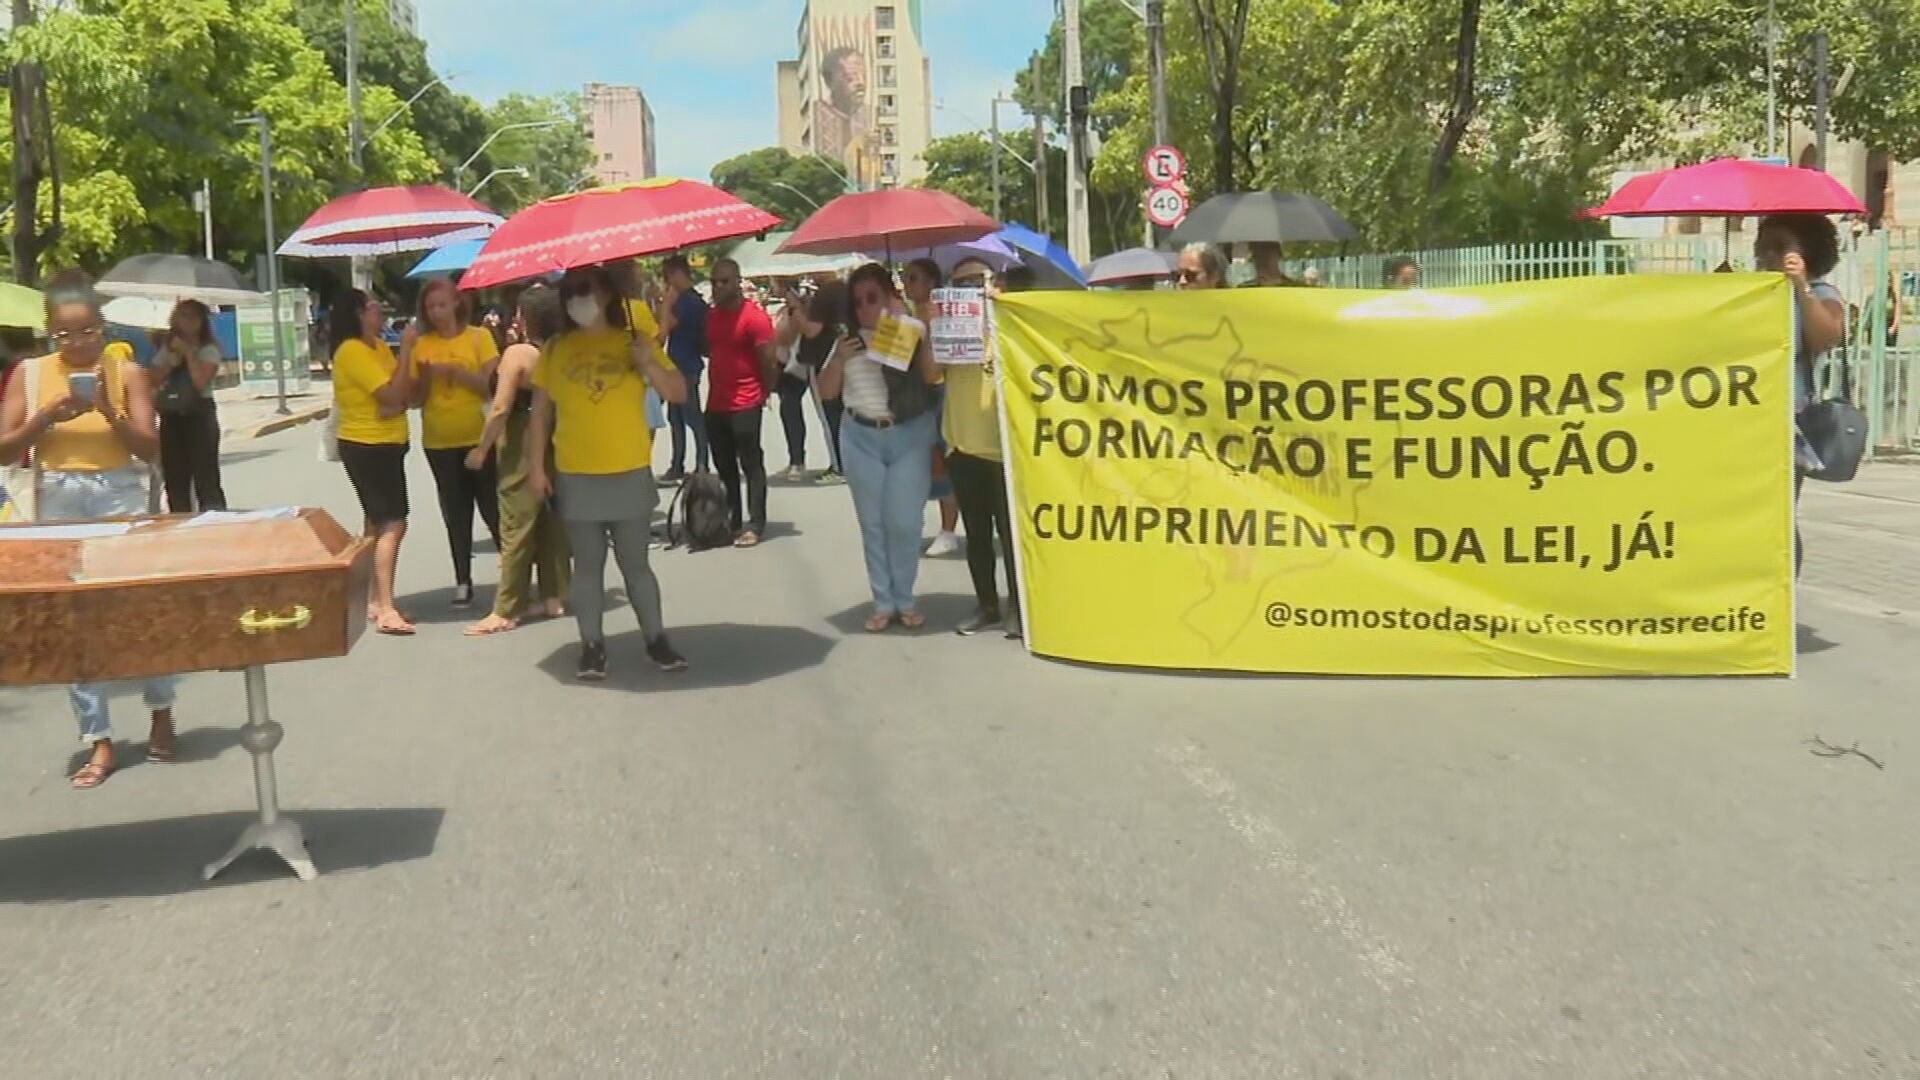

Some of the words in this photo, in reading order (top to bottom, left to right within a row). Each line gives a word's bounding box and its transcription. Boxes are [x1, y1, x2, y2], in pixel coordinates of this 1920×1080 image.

[1153, 196, 1179, 211] 40
[1030, 364, 1208, 417] SOMOS
[1225, 371, 1625, 421] PROFESSORAS
[1645, 365, 1760, 411] POR
[1033, 418, 1326, 479] FORMAÇÃO
[1346, 438, 1373, 479] E
[1393, 421, 1655, 490] FUNÇÃO.
[1034, 504, 1395, 559] CUMPRIMENTO
[1414, 527, 1486, 564] DA
[1504, 525, 1591, 569] LEI,
[1603, 511, 1675, 572] JÁ!
[1265, 602, 1766, 638] @somostodasprofessorasrecife
